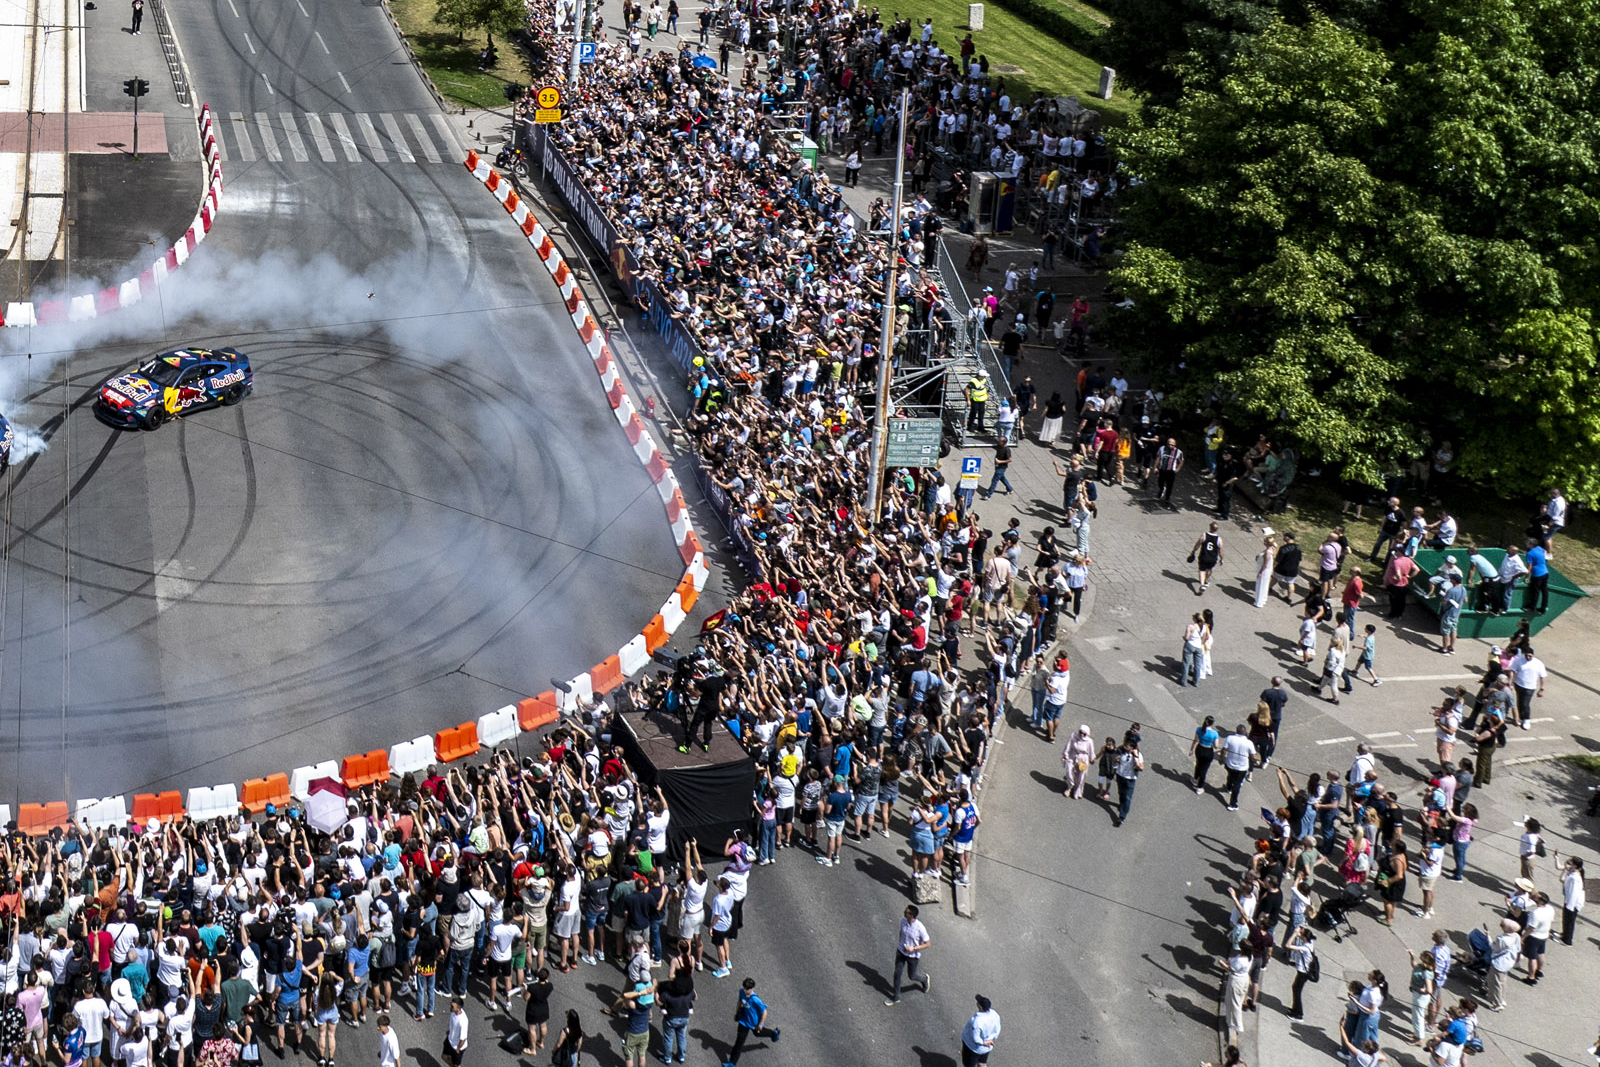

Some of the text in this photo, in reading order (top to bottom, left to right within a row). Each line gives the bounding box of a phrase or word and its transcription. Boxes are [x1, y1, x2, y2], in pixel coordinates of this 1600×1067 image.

[583, 44, 592, 56] P
[211, 368, 246, 390] Red Bull
[122, 384, 149, 403] Bull
[967, 459, 977, 471] P
[1206, 541, 1214, 551] 6
